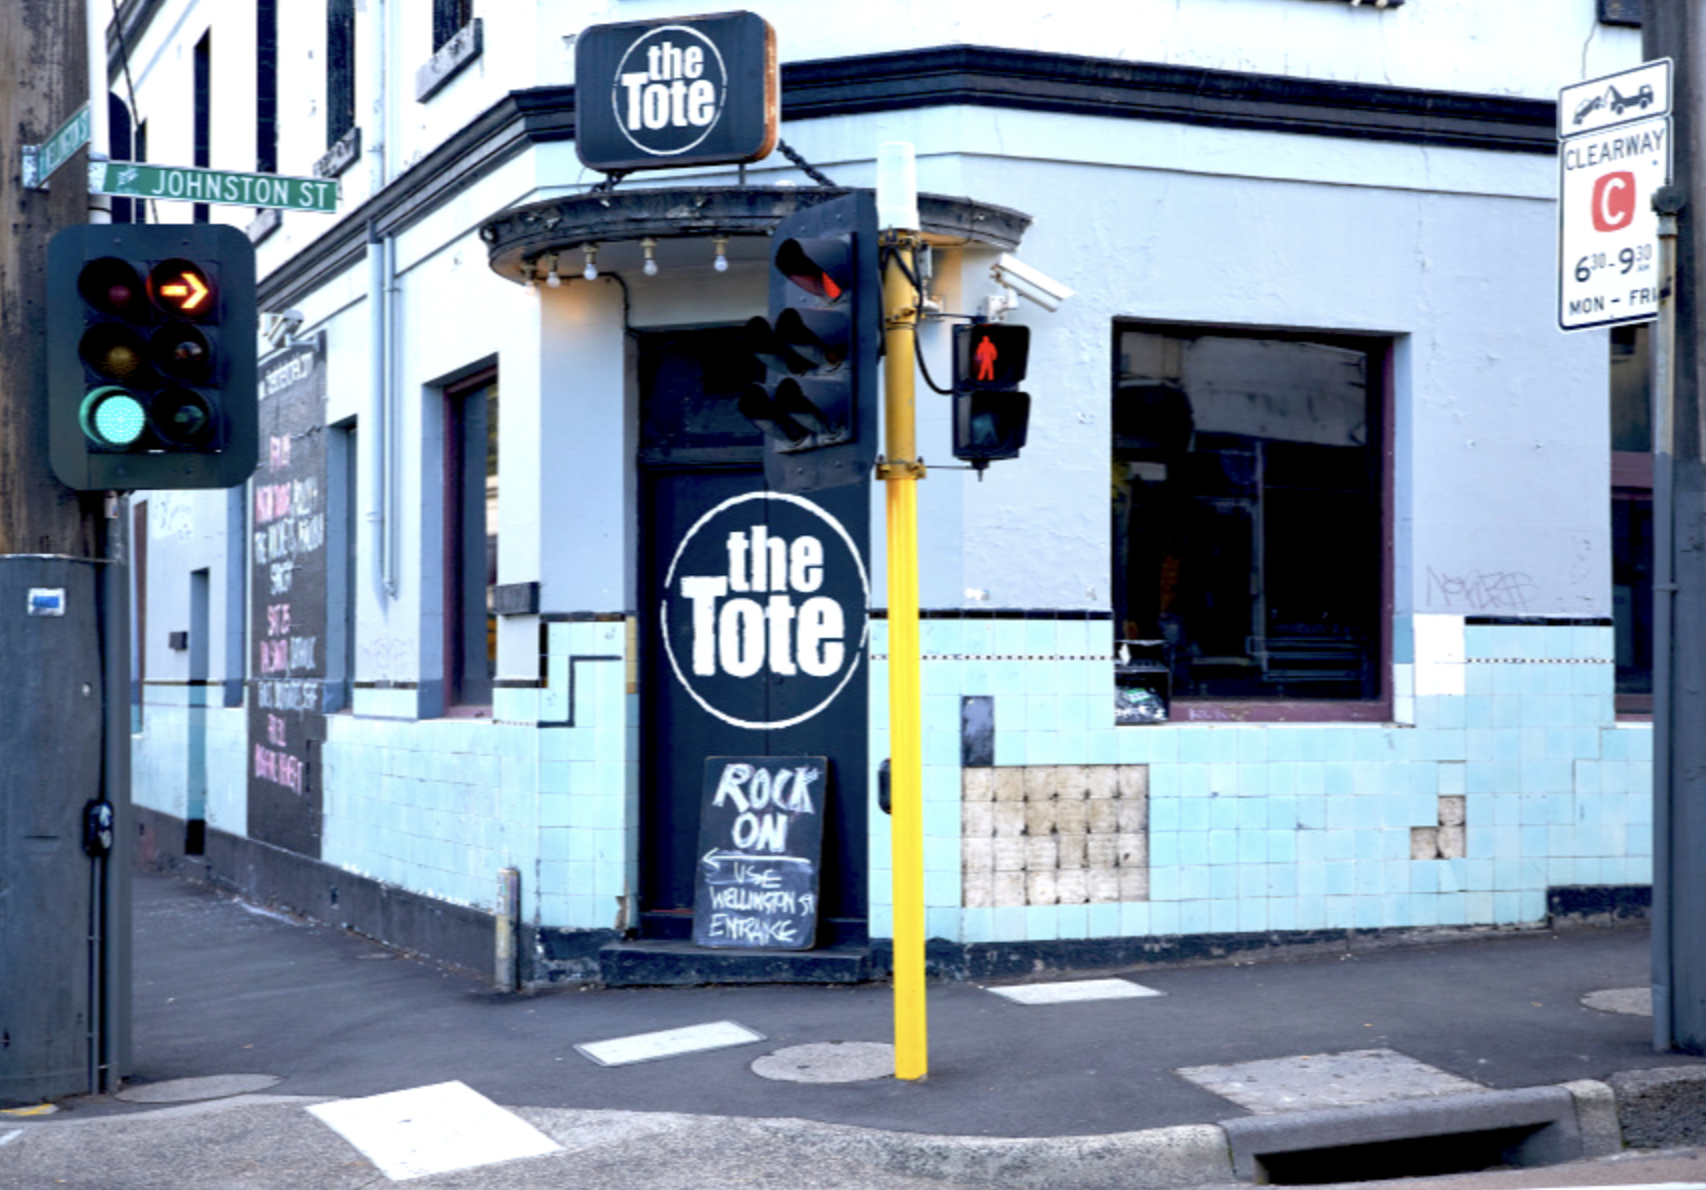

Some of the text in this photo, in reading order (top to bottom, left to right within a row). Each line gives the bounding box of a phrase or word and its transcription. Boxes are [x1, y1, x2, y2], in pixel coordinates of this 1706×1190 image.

[647, 41, 704, 81] the
[621, 72, 716, 130] Tote
[1563, 128, 1665, 171] CLEARWAY
[151, 169, 328, 208] JOHNSTON ST
[1601, 177, 1626, 226] C
[1568, 295, 1605, 316] MON
[1629, 287, 1658, 306] FRI
[726, 524, 824, 592] the
[680, 575, 845, 678] Tote
[712, 763, 821, 814] ROCK
[731, 812, 789, 853] ON
[734, 861, 782, 888] USE
[708, 886, 796, 914] WELLINGTON
